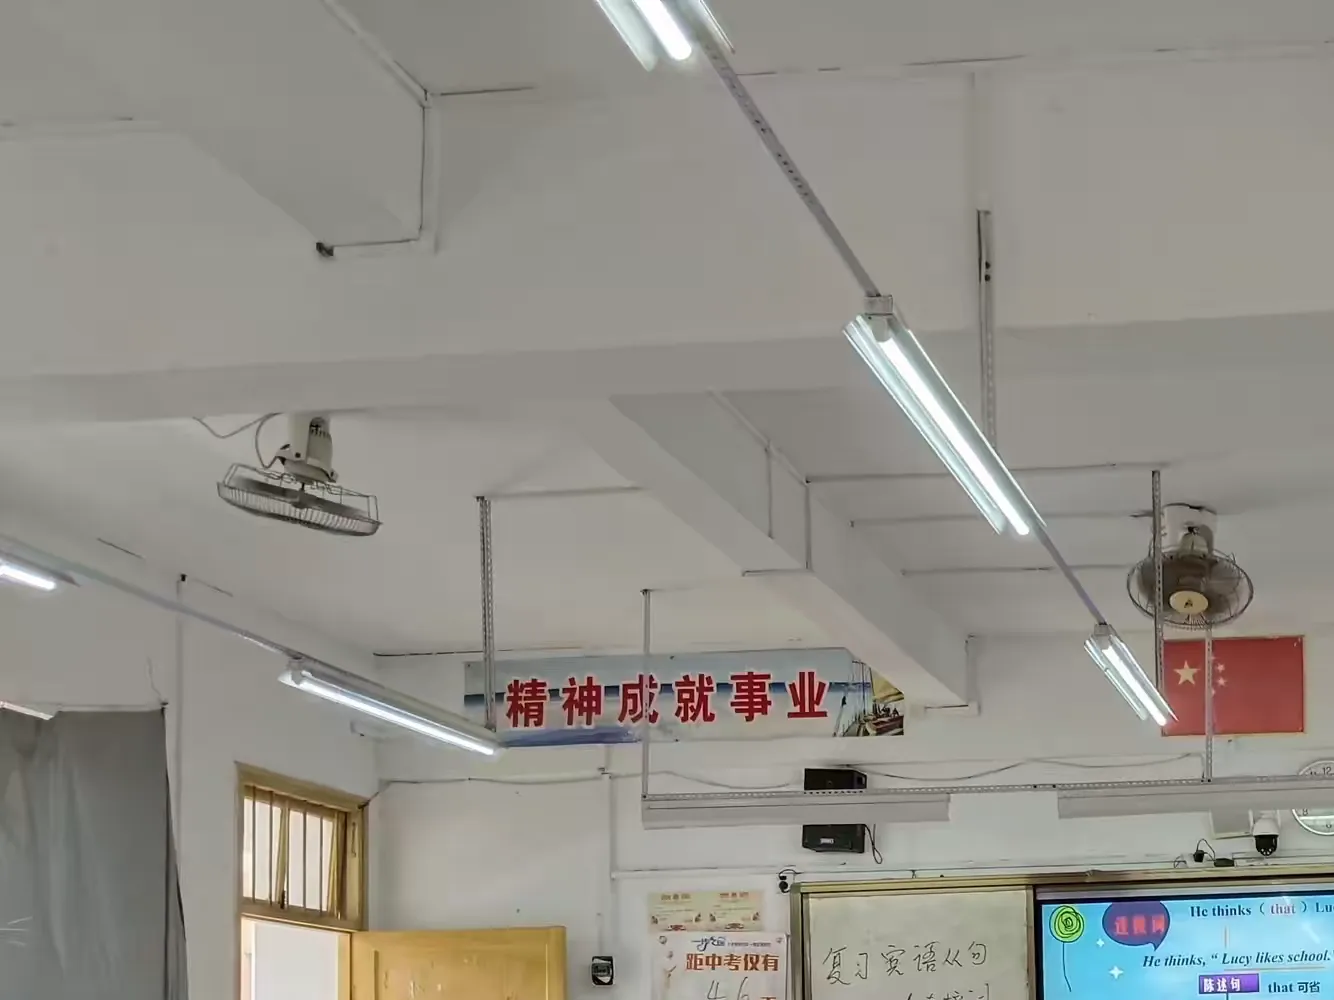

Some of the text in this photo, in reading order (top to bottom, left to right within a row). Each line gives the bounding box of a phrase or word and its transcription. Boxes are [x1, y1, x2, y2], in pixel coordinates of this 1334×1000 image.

[505, 670, 828, 728] 精神成就事业
[1190, 905, 1209, 918] He
[1212, 904, 1252, 917] thinks
[686, 953, 780, 972] 距中考仅有
[823, 941, 987, 985] 复习宾语从句
[1143, 955, 1161, 967] He
[1164, 953, 1206, 967] thinks,
[1255, 950, 1284, 964] likes
[1203, 977, 1242, 993] 陈述句
[1268, 980, 1321, 994] that 可省
